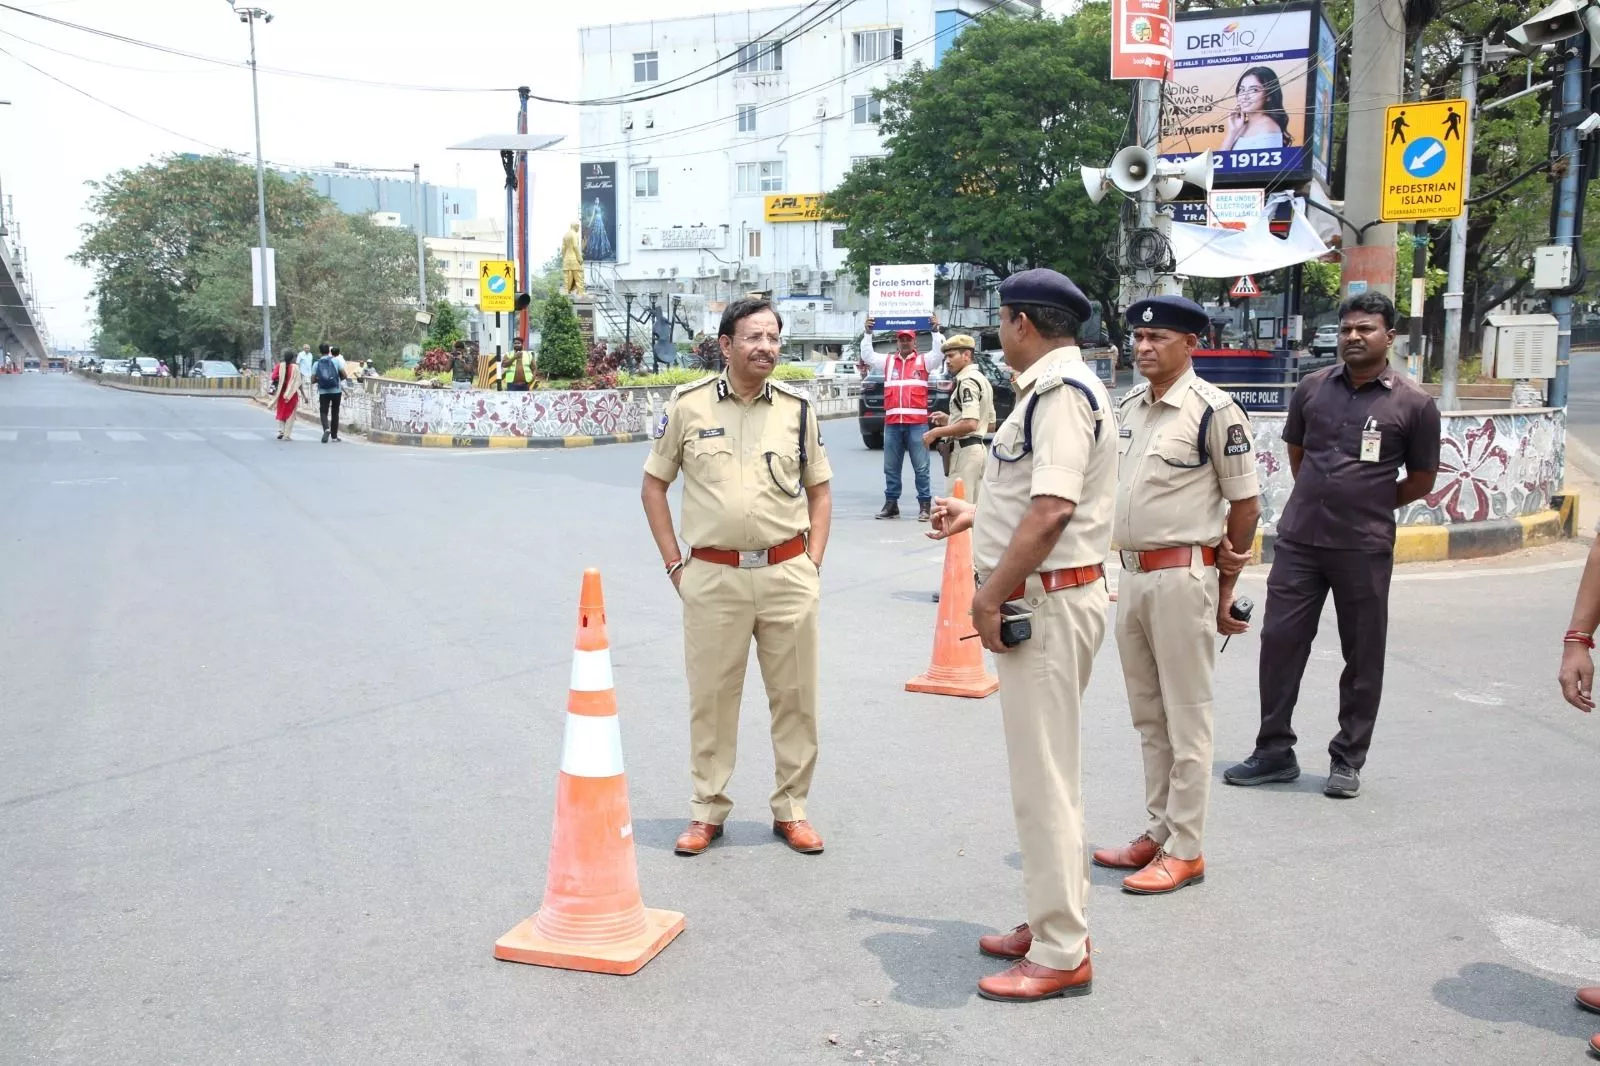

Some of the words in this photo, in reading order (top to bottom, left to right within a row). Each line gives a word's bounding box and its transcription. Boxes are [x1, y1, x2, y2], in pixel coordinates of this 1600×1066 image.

[1187, 30, 1255, 50] DERMIQ
[1250, 53, 1284, 61] KONDAPUR
[1164, 85, 1199, 96] ADING
[1174, 96, 1199, 105] WAY
[1201, 94, 1214, 104] IN
[1230, 151, 1282, 168] 19123
[1389, 182, 1456, 194] PEDESTRIAN
[1401, 194, 1442, 205] ISLAND
[1183, 203, 1207, 211] HY
[1183, 213, 1206, 221] TRA
[872, 279, 899, 287] Circle
[901, 278, 932, 287] Smart.
[880, 290, 896, 298] Not
[898, 289, 924, 298] Hard.
[1258, 391, 1279, 404] POLICE
